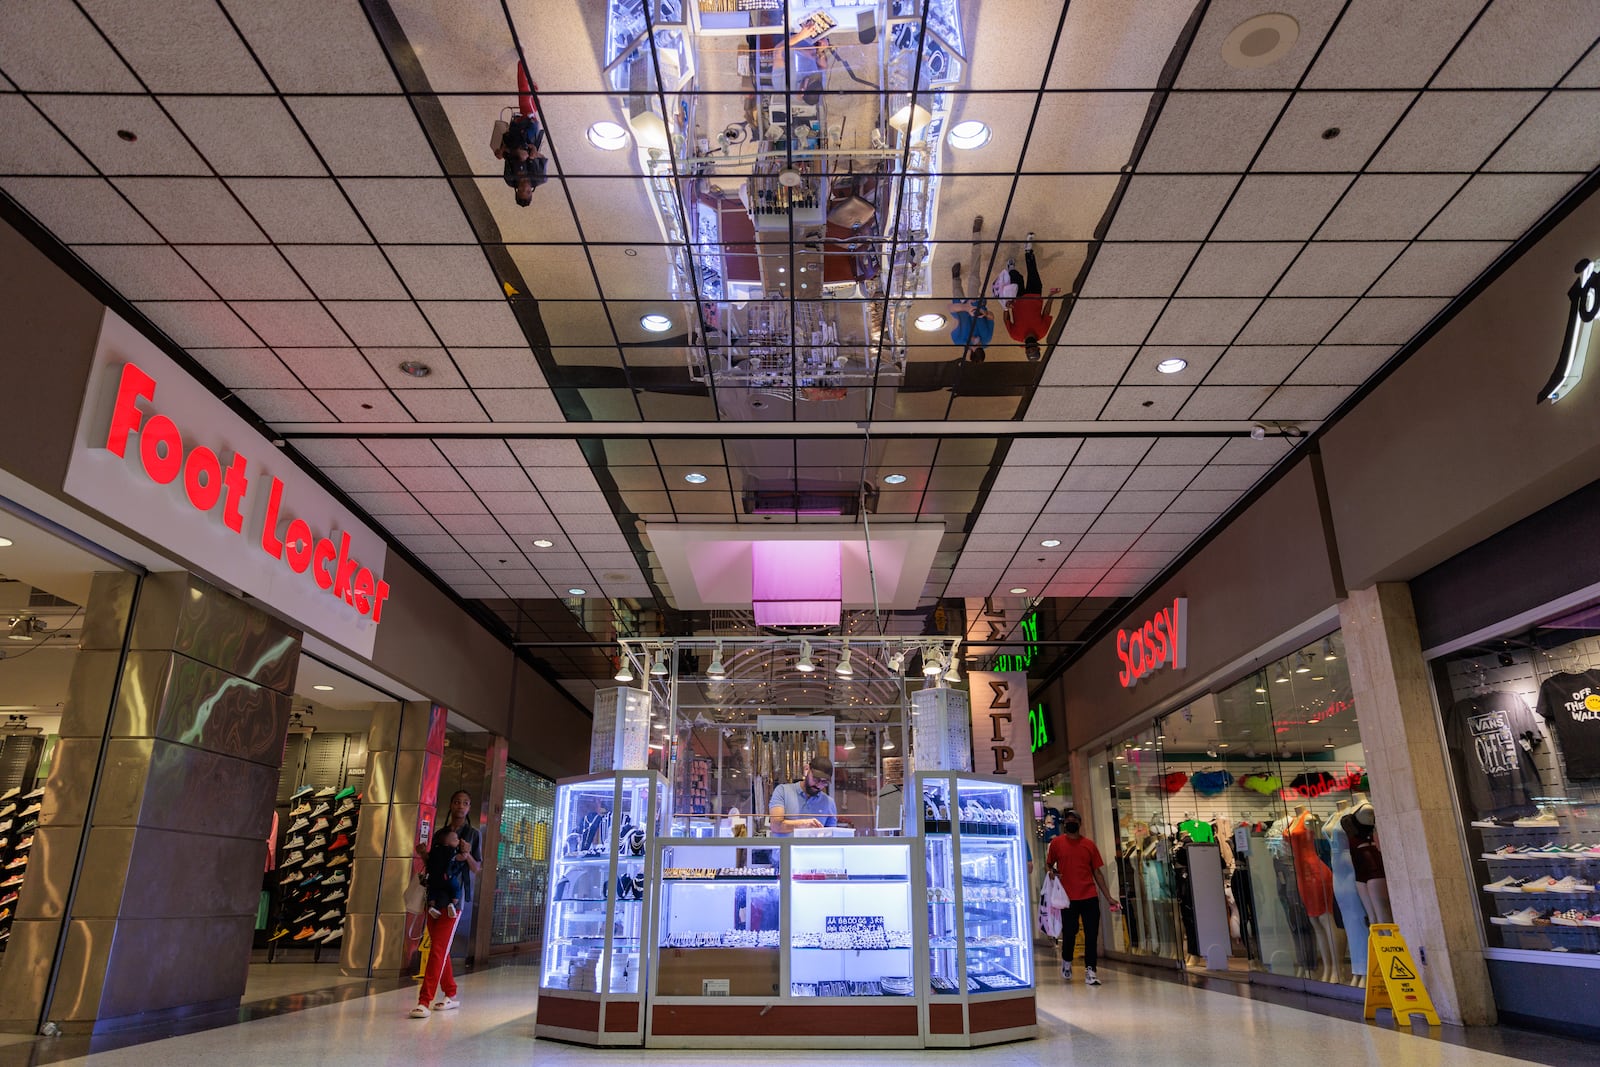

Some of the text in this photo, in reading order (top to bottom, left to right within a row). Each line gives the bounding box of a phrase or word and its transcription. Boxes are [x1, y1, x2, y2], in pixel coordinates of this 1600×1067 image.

[106, 362, 390, 625] Foot Locker
[1117, 598, 1178, 688] Sassy
[1572, 687, 1592, 701] OFF
[1564, 701, 1586, 712] THE
[1475, 714, 1505, 732] VANS
[1571, 711, 1600, 722] WALL
